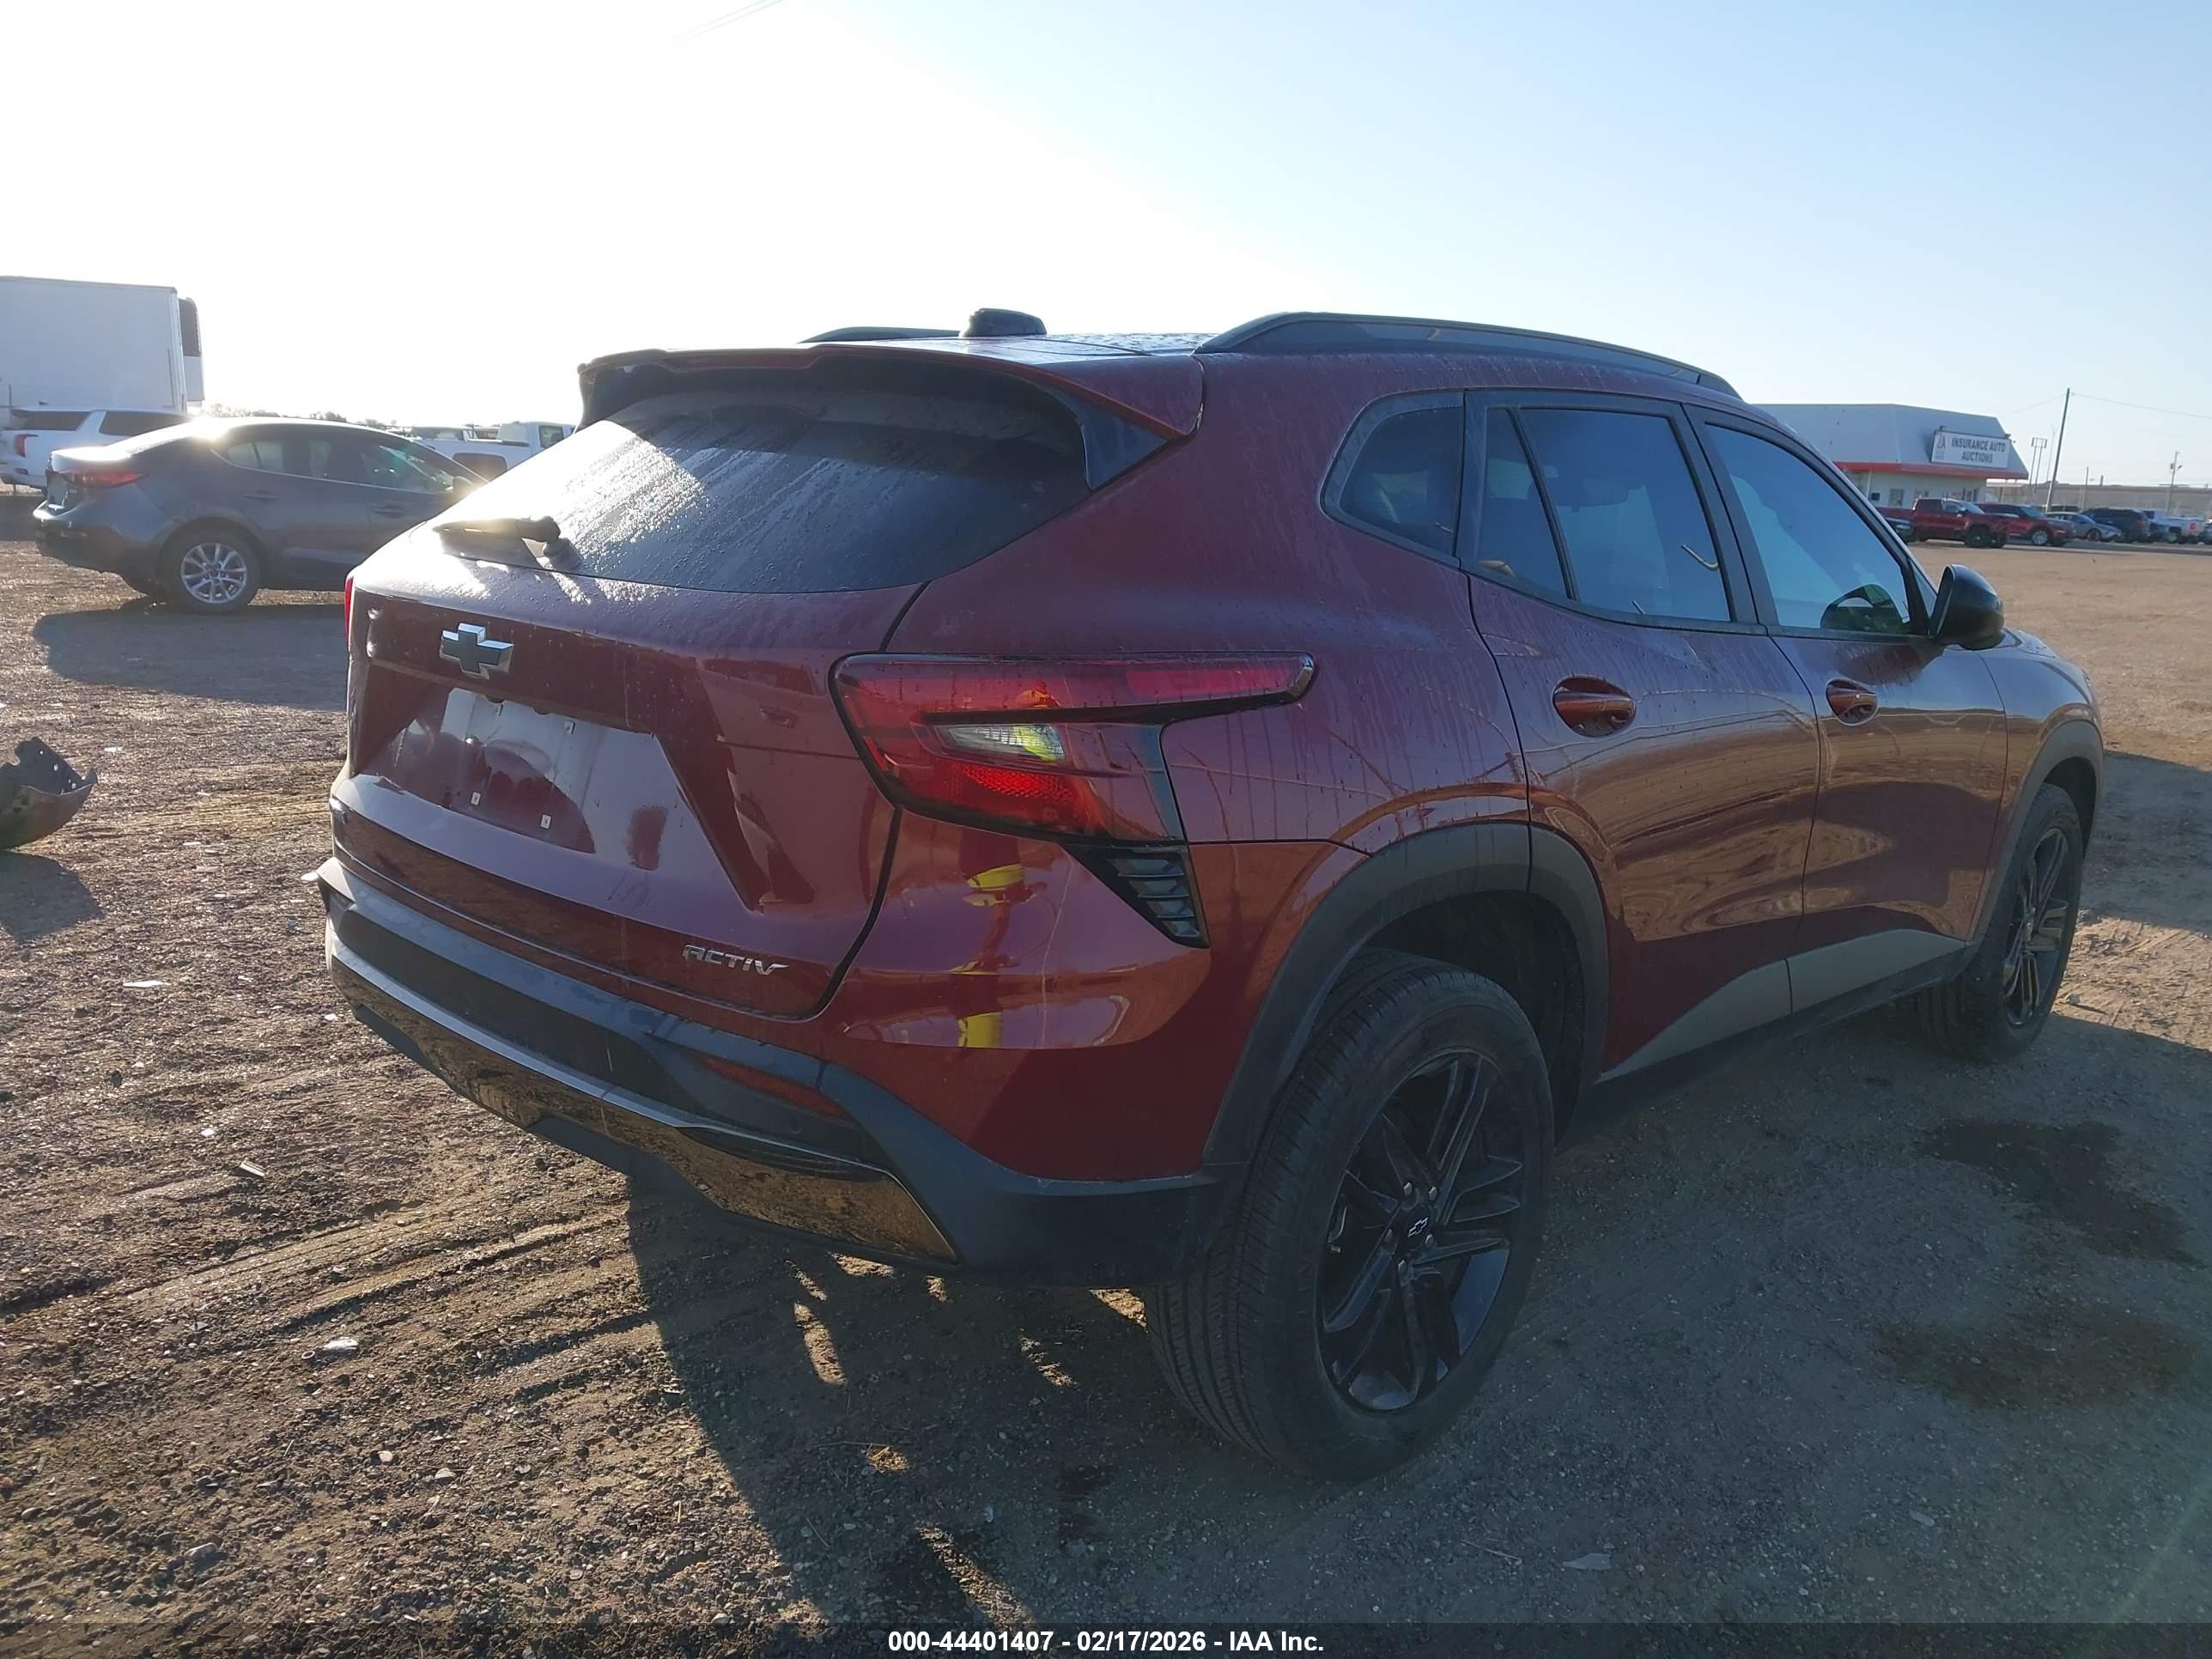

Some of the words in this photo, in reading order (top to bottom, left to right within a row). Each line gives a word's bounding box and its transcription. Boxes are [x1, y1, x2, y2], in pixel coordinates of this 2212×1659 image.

[1952, 438, 1988, 450] INSURANCE
[1989, 441, 2006, 452] AUTO
[1961, 452, 1993, 463] AUCTIONS
[682, 945, 789, 975] ACTIV
